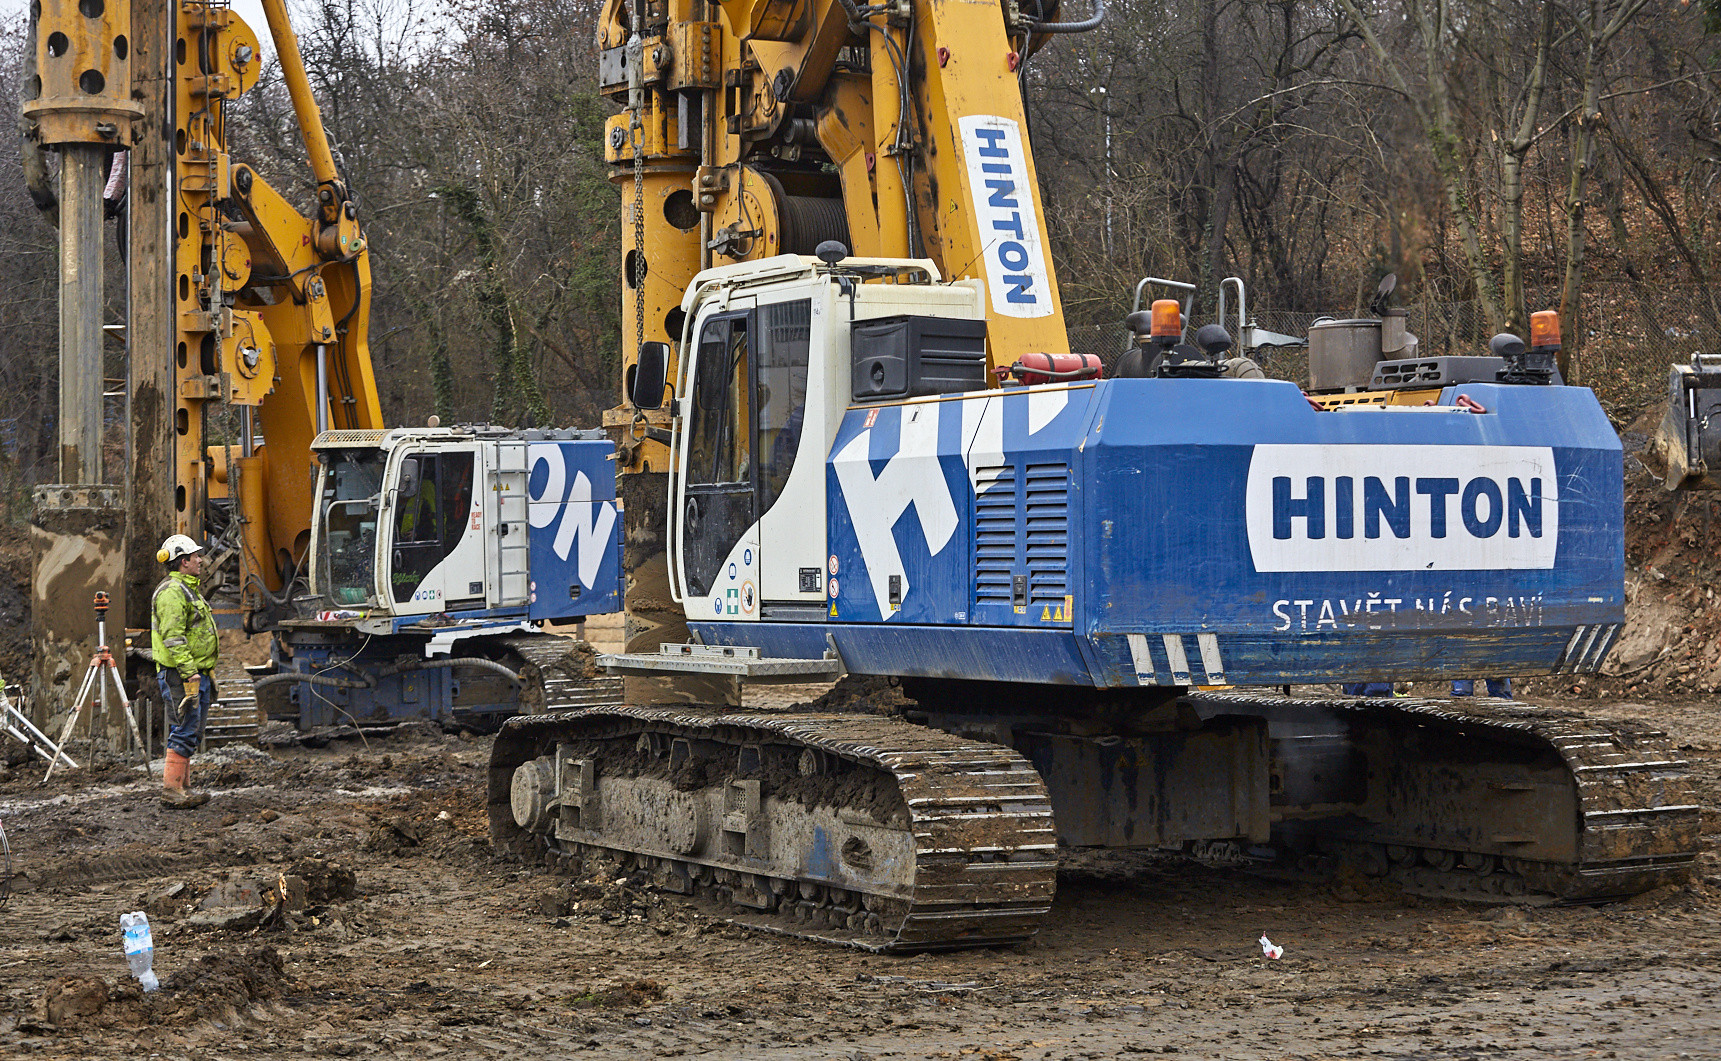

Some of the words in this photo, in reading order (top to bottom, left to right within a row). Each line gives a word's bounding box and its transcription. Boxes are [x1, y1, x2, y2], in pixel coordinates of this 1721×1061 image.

[975, 128, 1037, 304] HINTON
[1272, 475, 1542, 540] HINTON
[1272, 592, 1402, 632] STAVĚT
